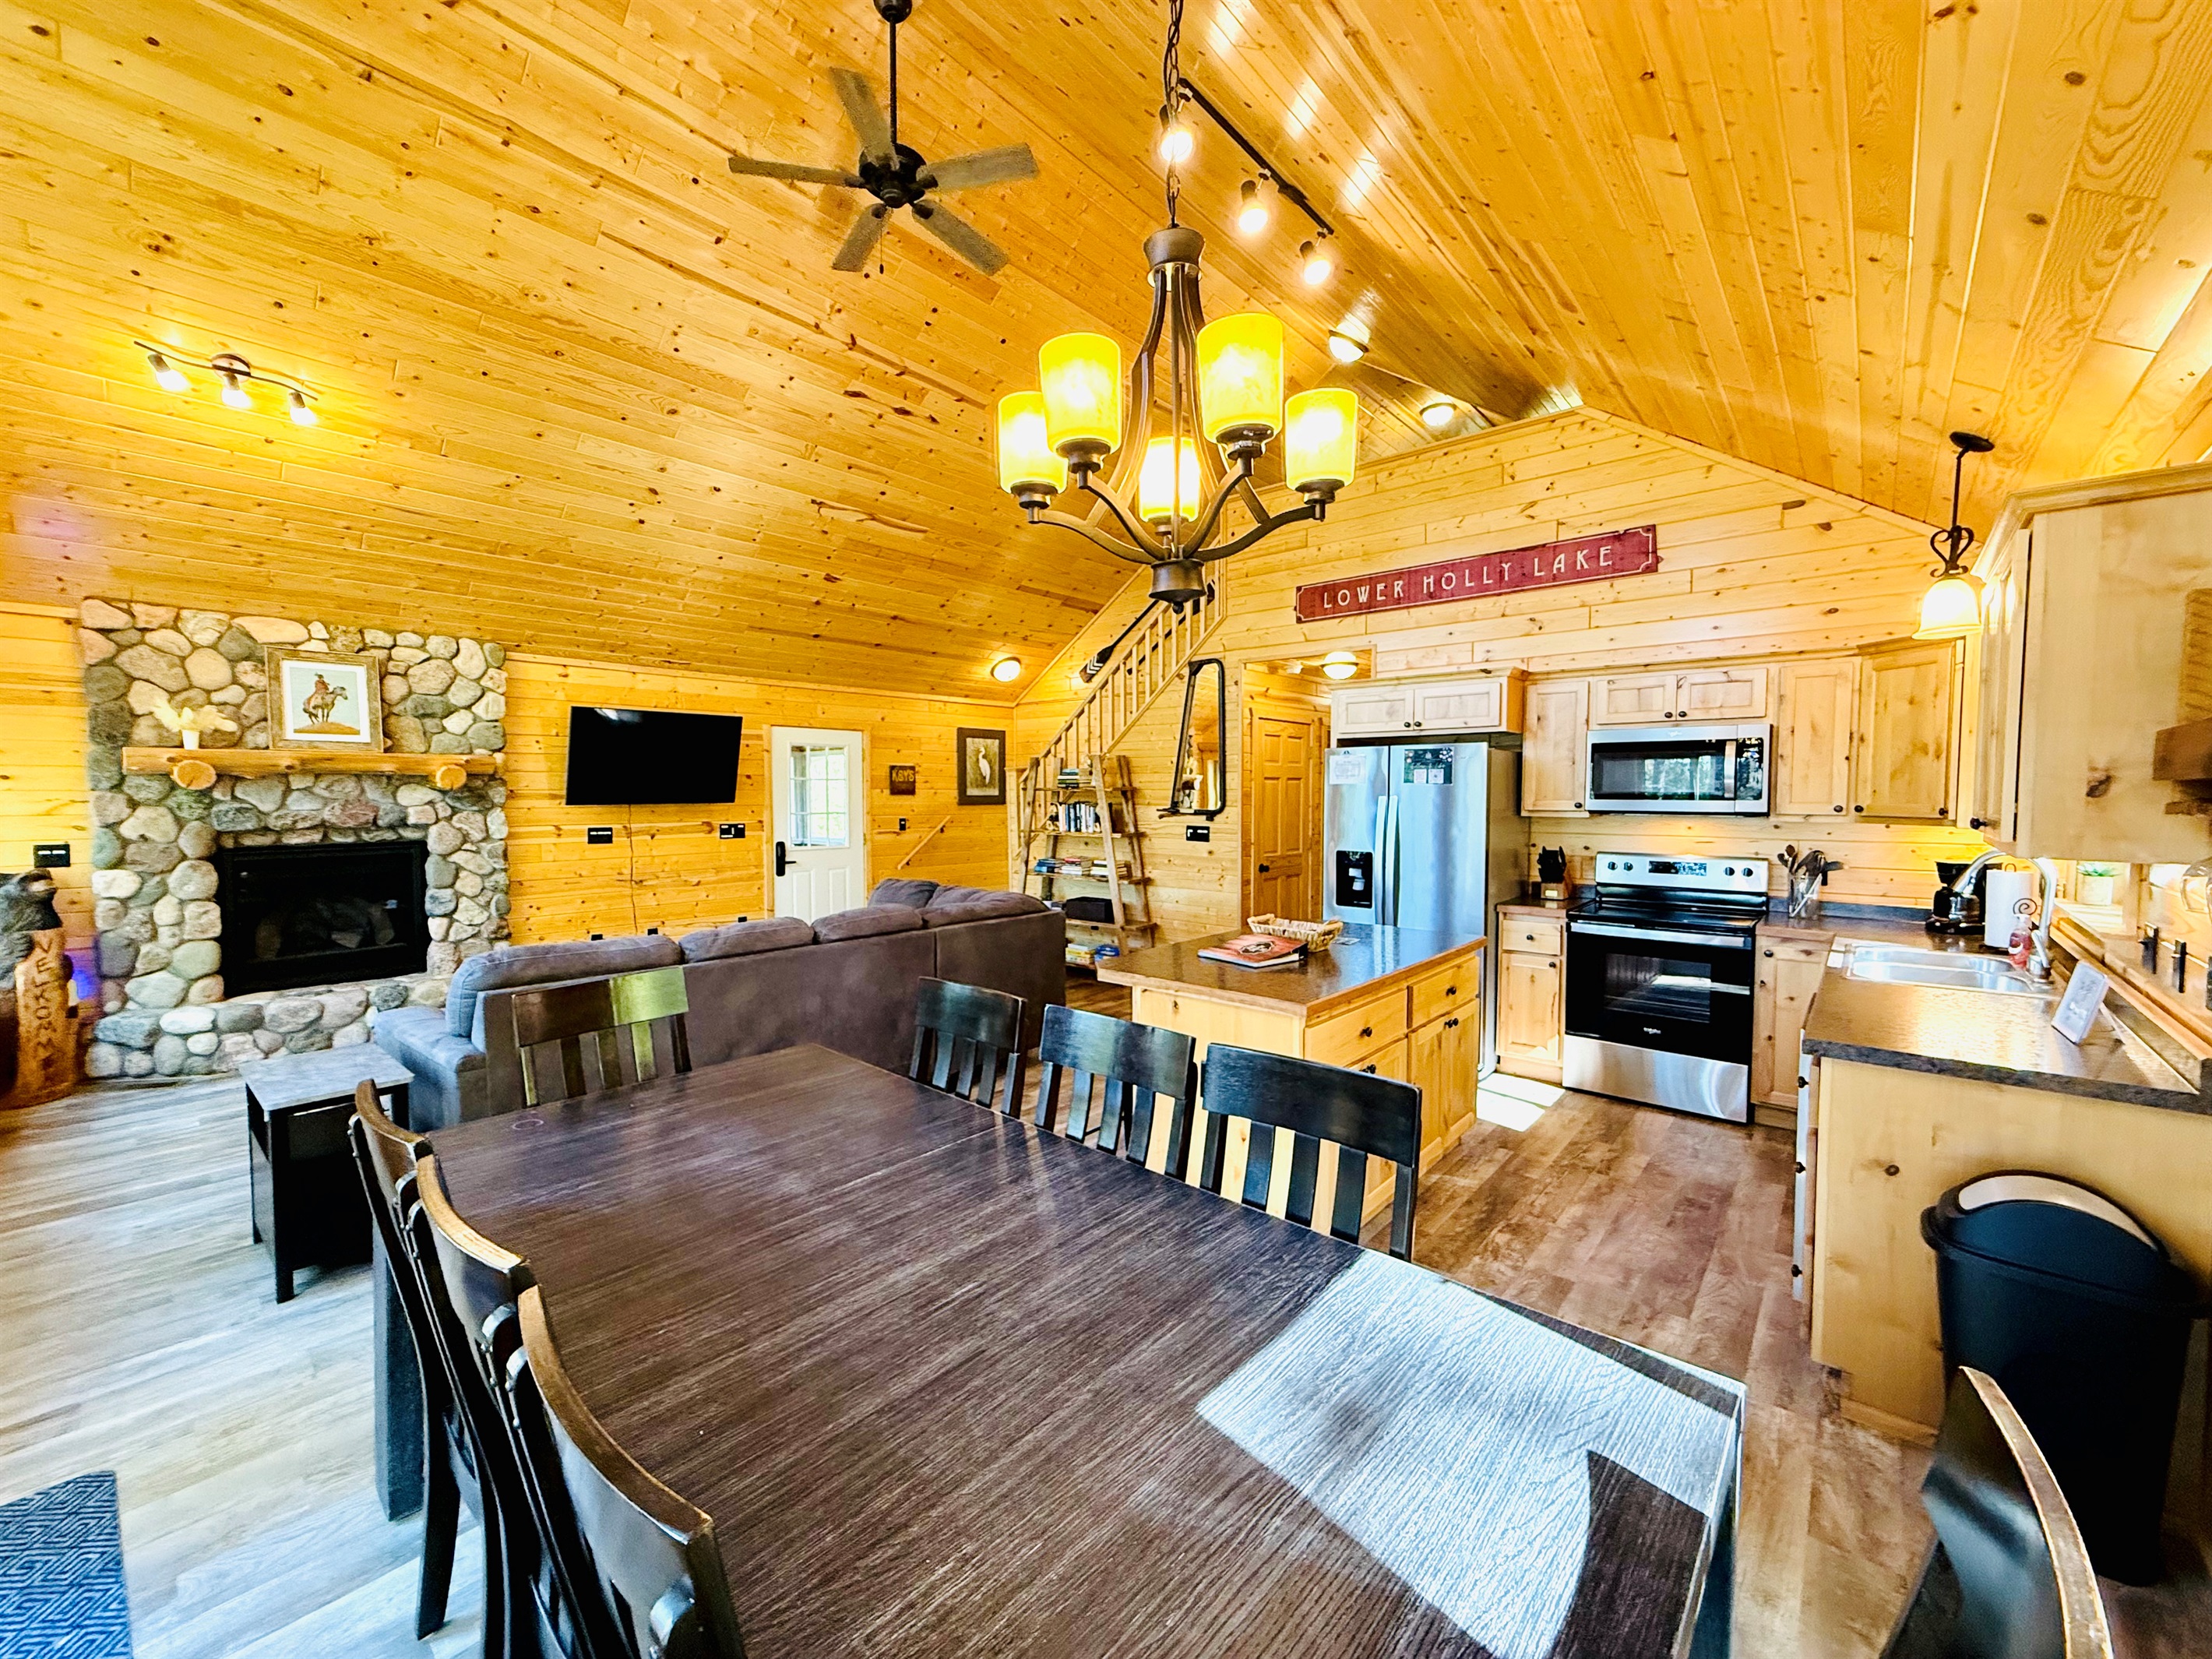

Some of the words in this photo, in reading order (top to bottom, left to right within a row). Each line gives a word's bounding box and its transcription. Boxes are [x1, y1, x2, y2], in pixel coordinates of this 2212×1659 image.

[1324, 581, 1404, 608] LOWER
[1423, 562, 1511, 594] HOLLY
[1534, 545, 1612, 576] LAKE
